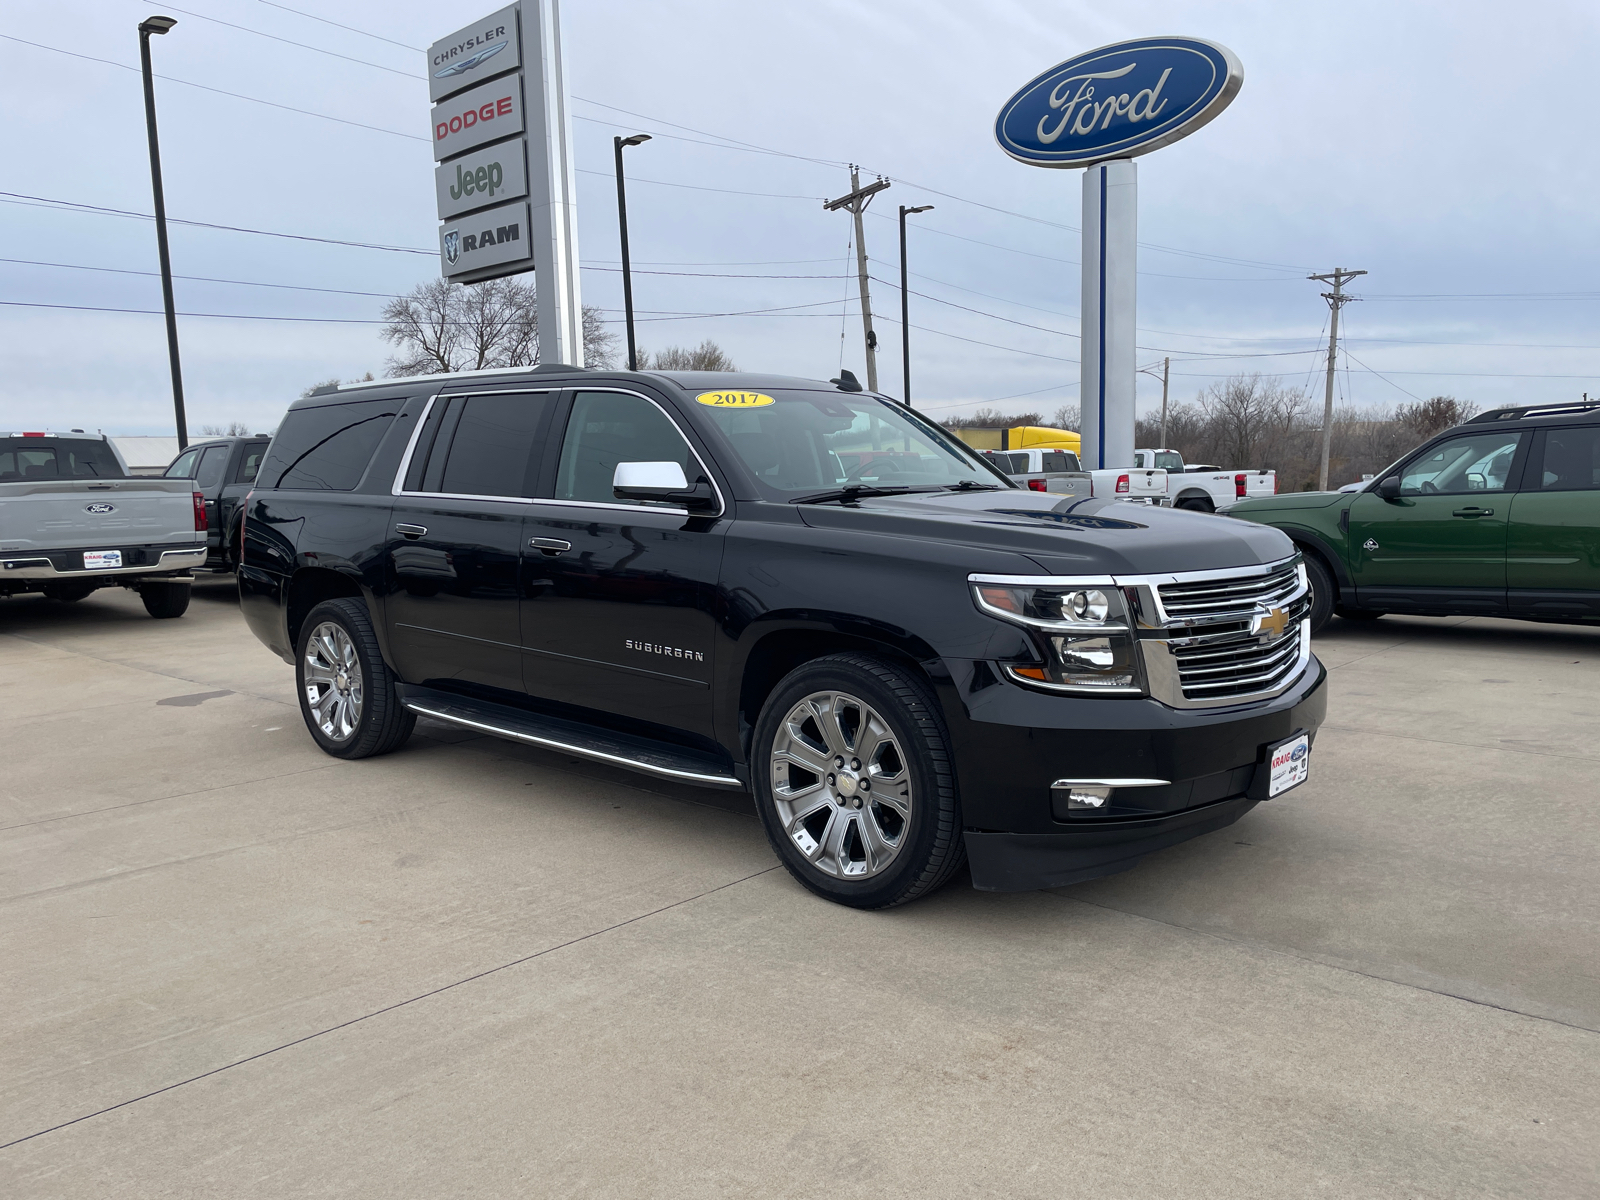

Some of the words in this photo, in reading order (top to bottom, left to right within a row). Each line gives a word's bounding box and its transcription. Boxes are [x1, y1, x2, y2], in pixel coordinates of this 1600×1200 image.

[433, 25, 506, 66] CHRYSLER
[1036, 62, 1173, 144] Ford
[436, 96, 513, 141] DODGE
[450, 161, 503, 200] Jeep
[462, 223, 520, 253] RAM
[712, 394, 759, 405] 2017
[90, 504, 110, 512] Ford
[625, 639, 704, 662] SUBURBAN
[1272, 752, 1290, 769] KRAIG
